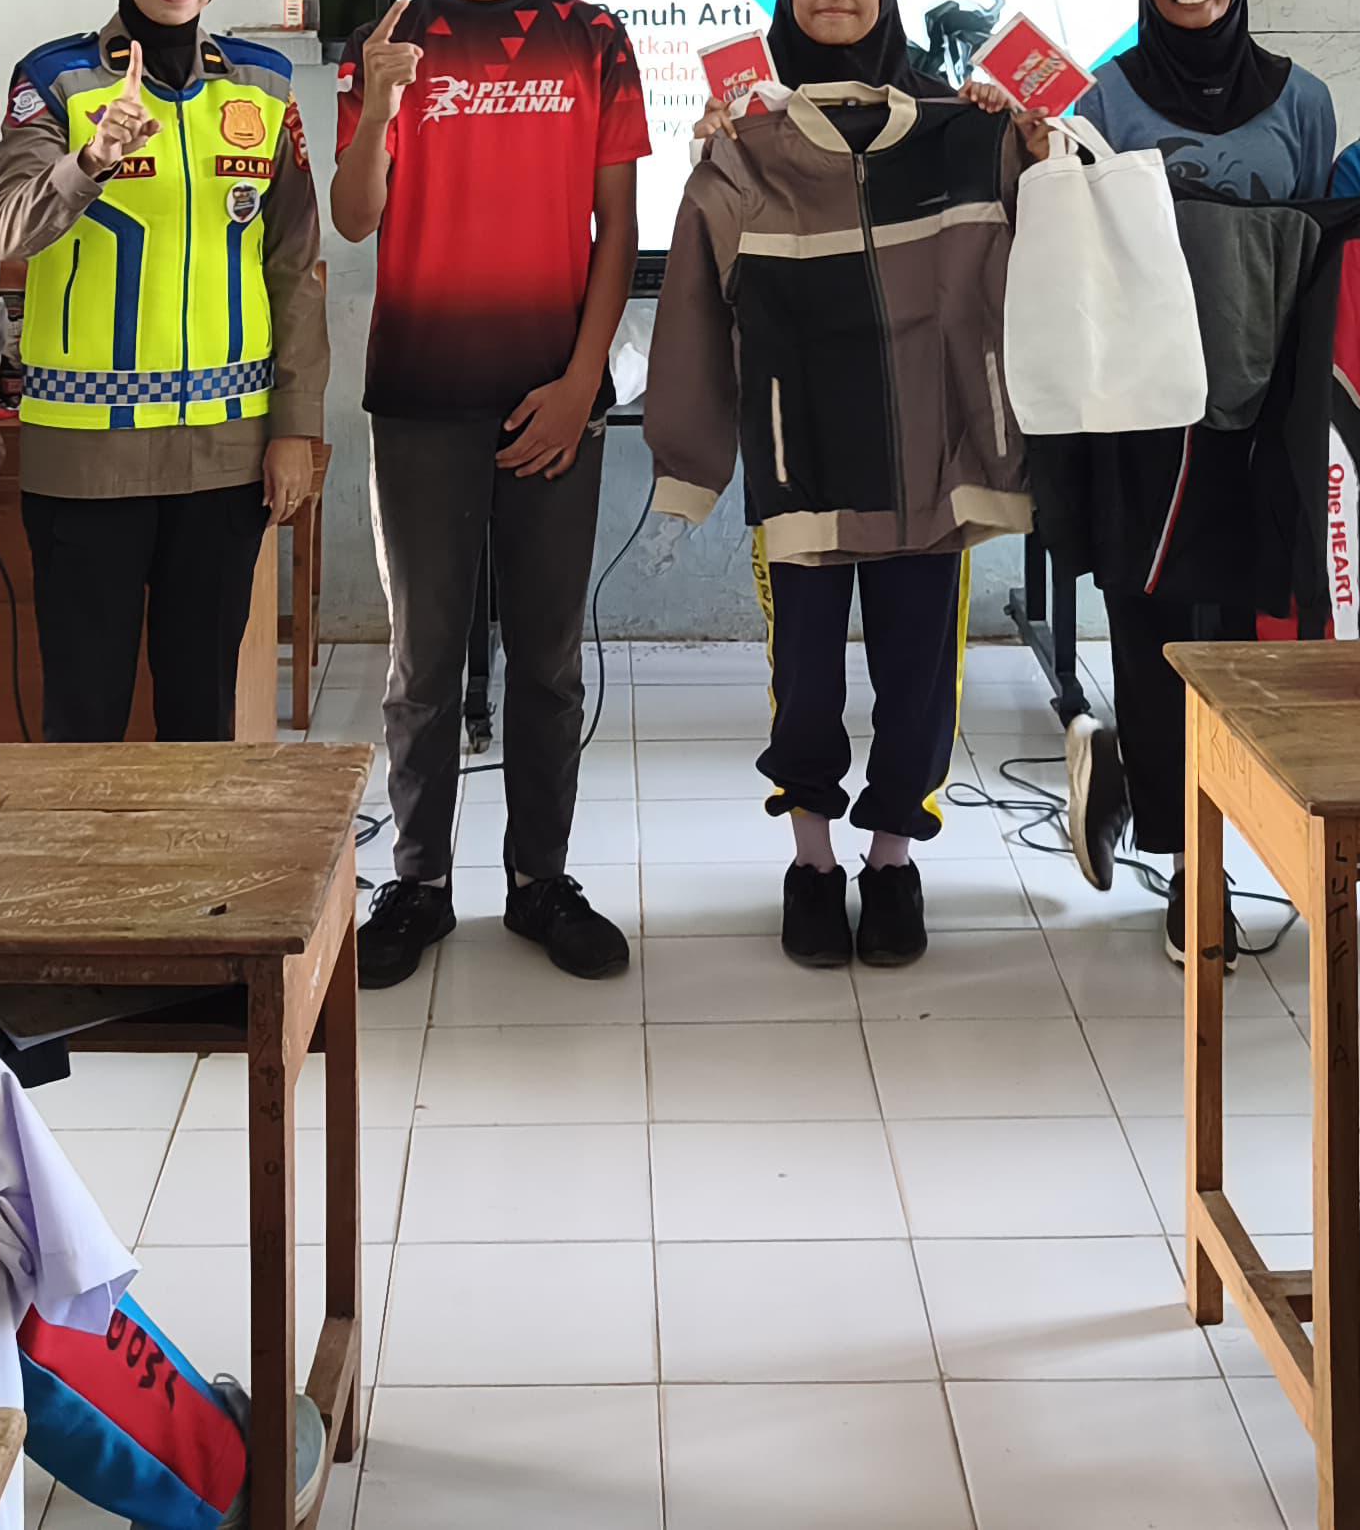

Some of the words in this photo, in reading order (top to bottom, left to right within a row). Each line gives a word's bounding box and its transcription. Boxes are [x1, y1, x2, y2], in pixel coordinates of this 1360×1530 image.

[698, 2, 751, 26] Arti
[476, 80, 564, 98] PELARI
[464, 97, 576, 115] JALANAN
[222, 160, 271, 174] POLRI
[1328, 463, 1345, 514] One
